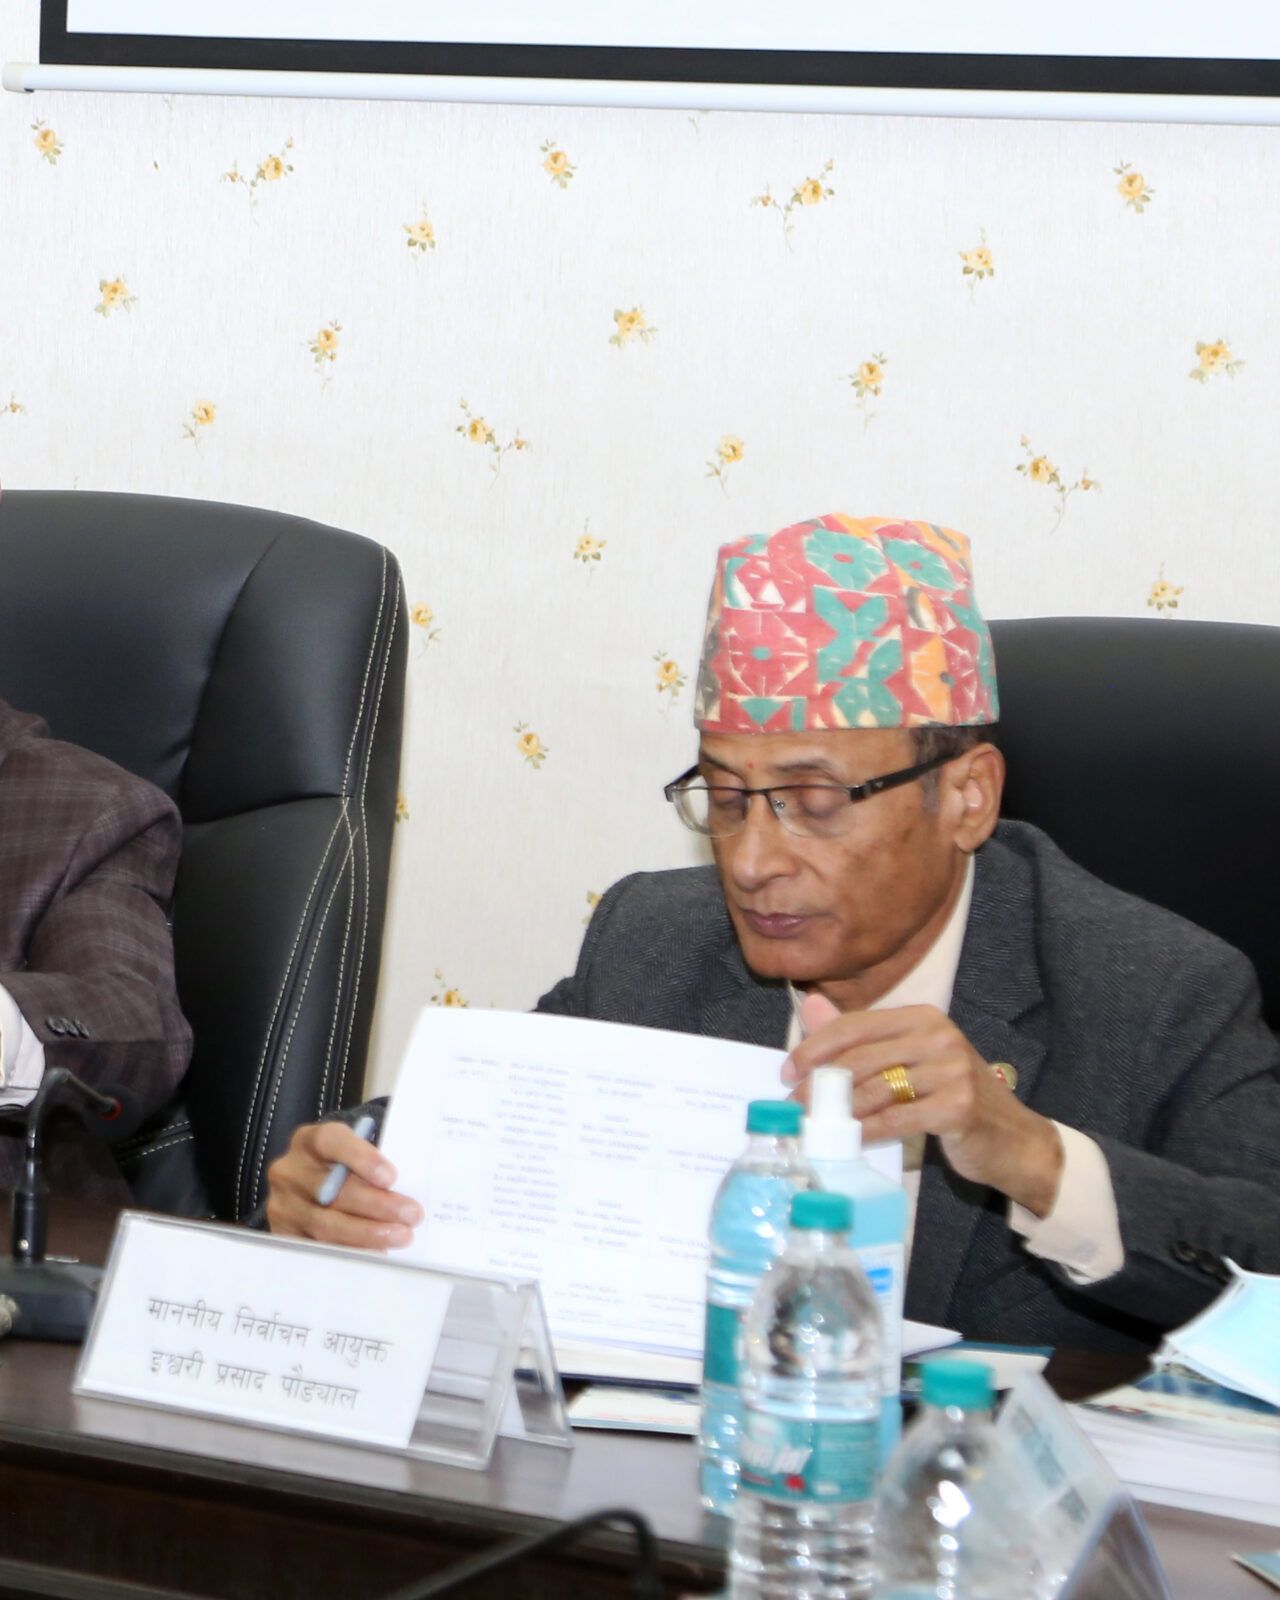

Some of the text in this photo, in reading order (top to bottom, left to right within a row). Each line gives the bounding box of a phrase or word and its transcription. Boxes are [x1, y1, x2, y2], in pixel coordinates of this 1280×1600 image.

[148, 1298, 394, 1368] माननीय निर्वाचन आयुक्त
[216, 1363, 271, 1390] प्रसाद
